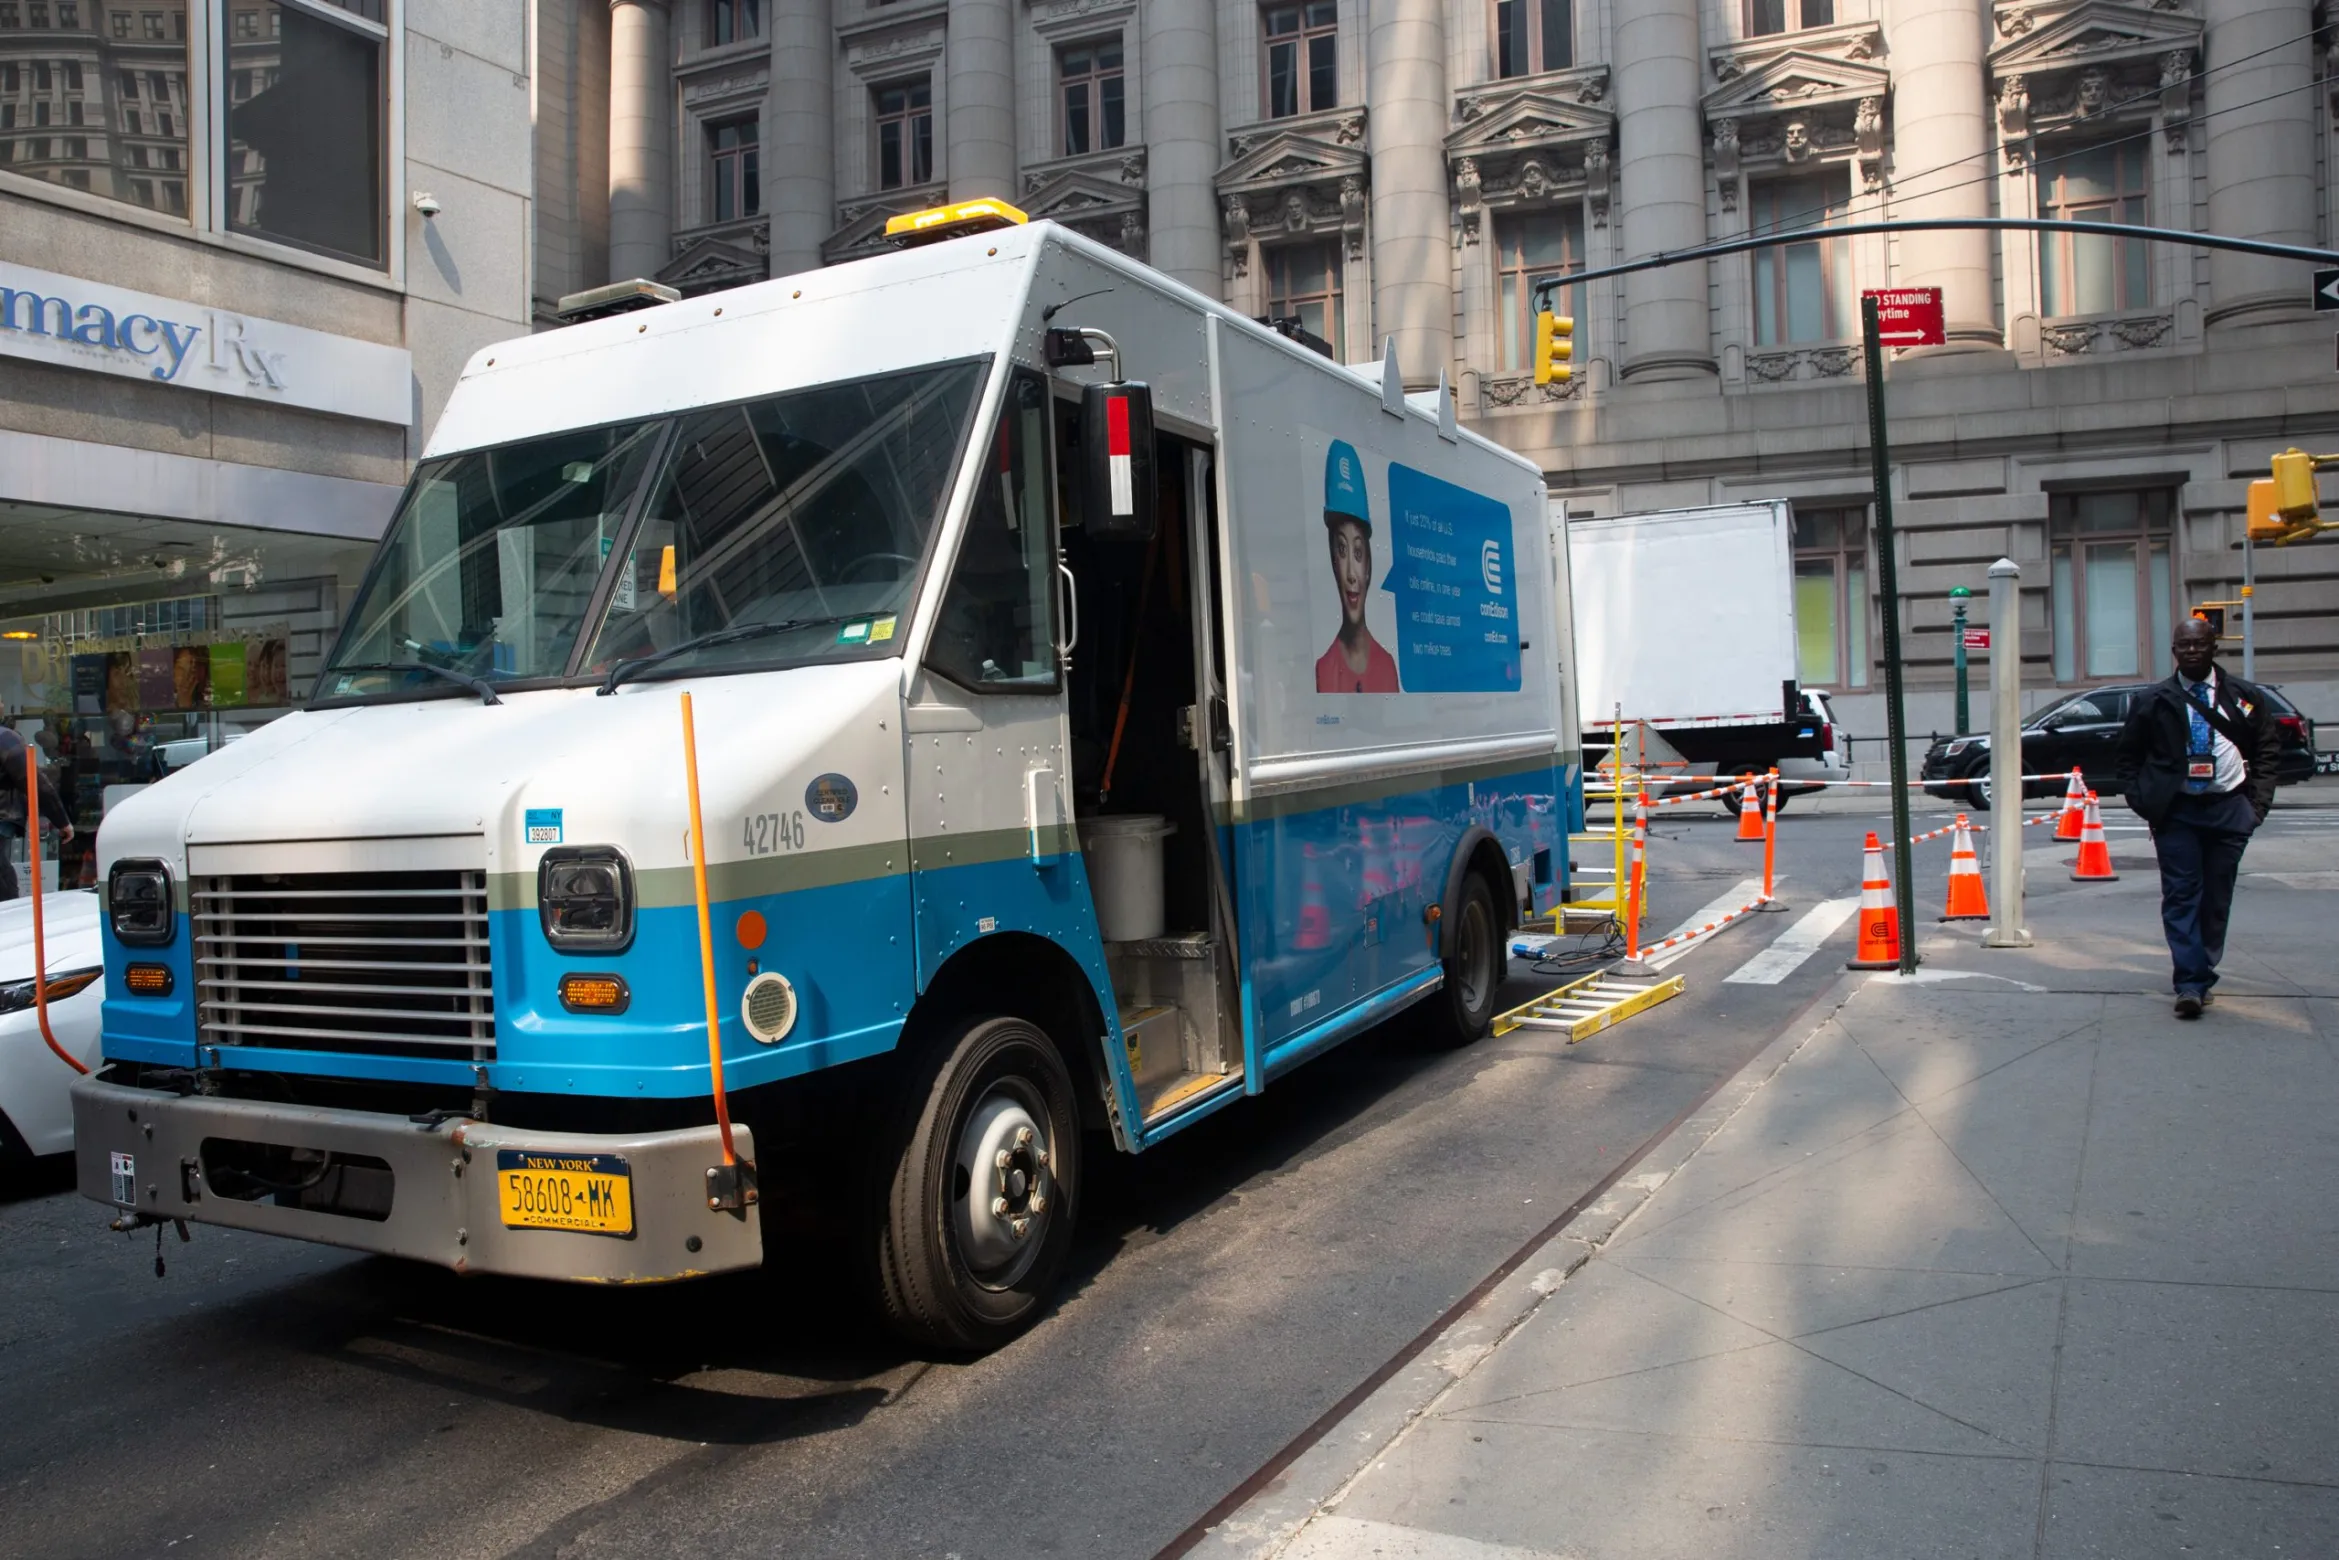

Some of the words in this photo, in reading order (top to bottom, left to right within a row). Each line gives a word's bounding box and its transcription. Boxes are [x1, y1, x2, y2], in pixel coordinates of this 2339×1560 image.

[1883, 293, 1931, 306] STANDING
[1877, 307, 1909, 322] nytime
[0, 287, 201, 380] macy
[1480, 601, 1508, 619] conEdison
[551, 811, 561, 820] NY
[531, 827, 558, 842] 392807
[743, 810, 805, 855] 42746
[528, 1157, 556, 1170] NEW
[558, 1159, 593, 1172] YORK
[509, 1174, 572, 1215] 58608
[587, 1179, 616, 1218] MK
[530, 1215, 599, 1228] COMMERCIAL
